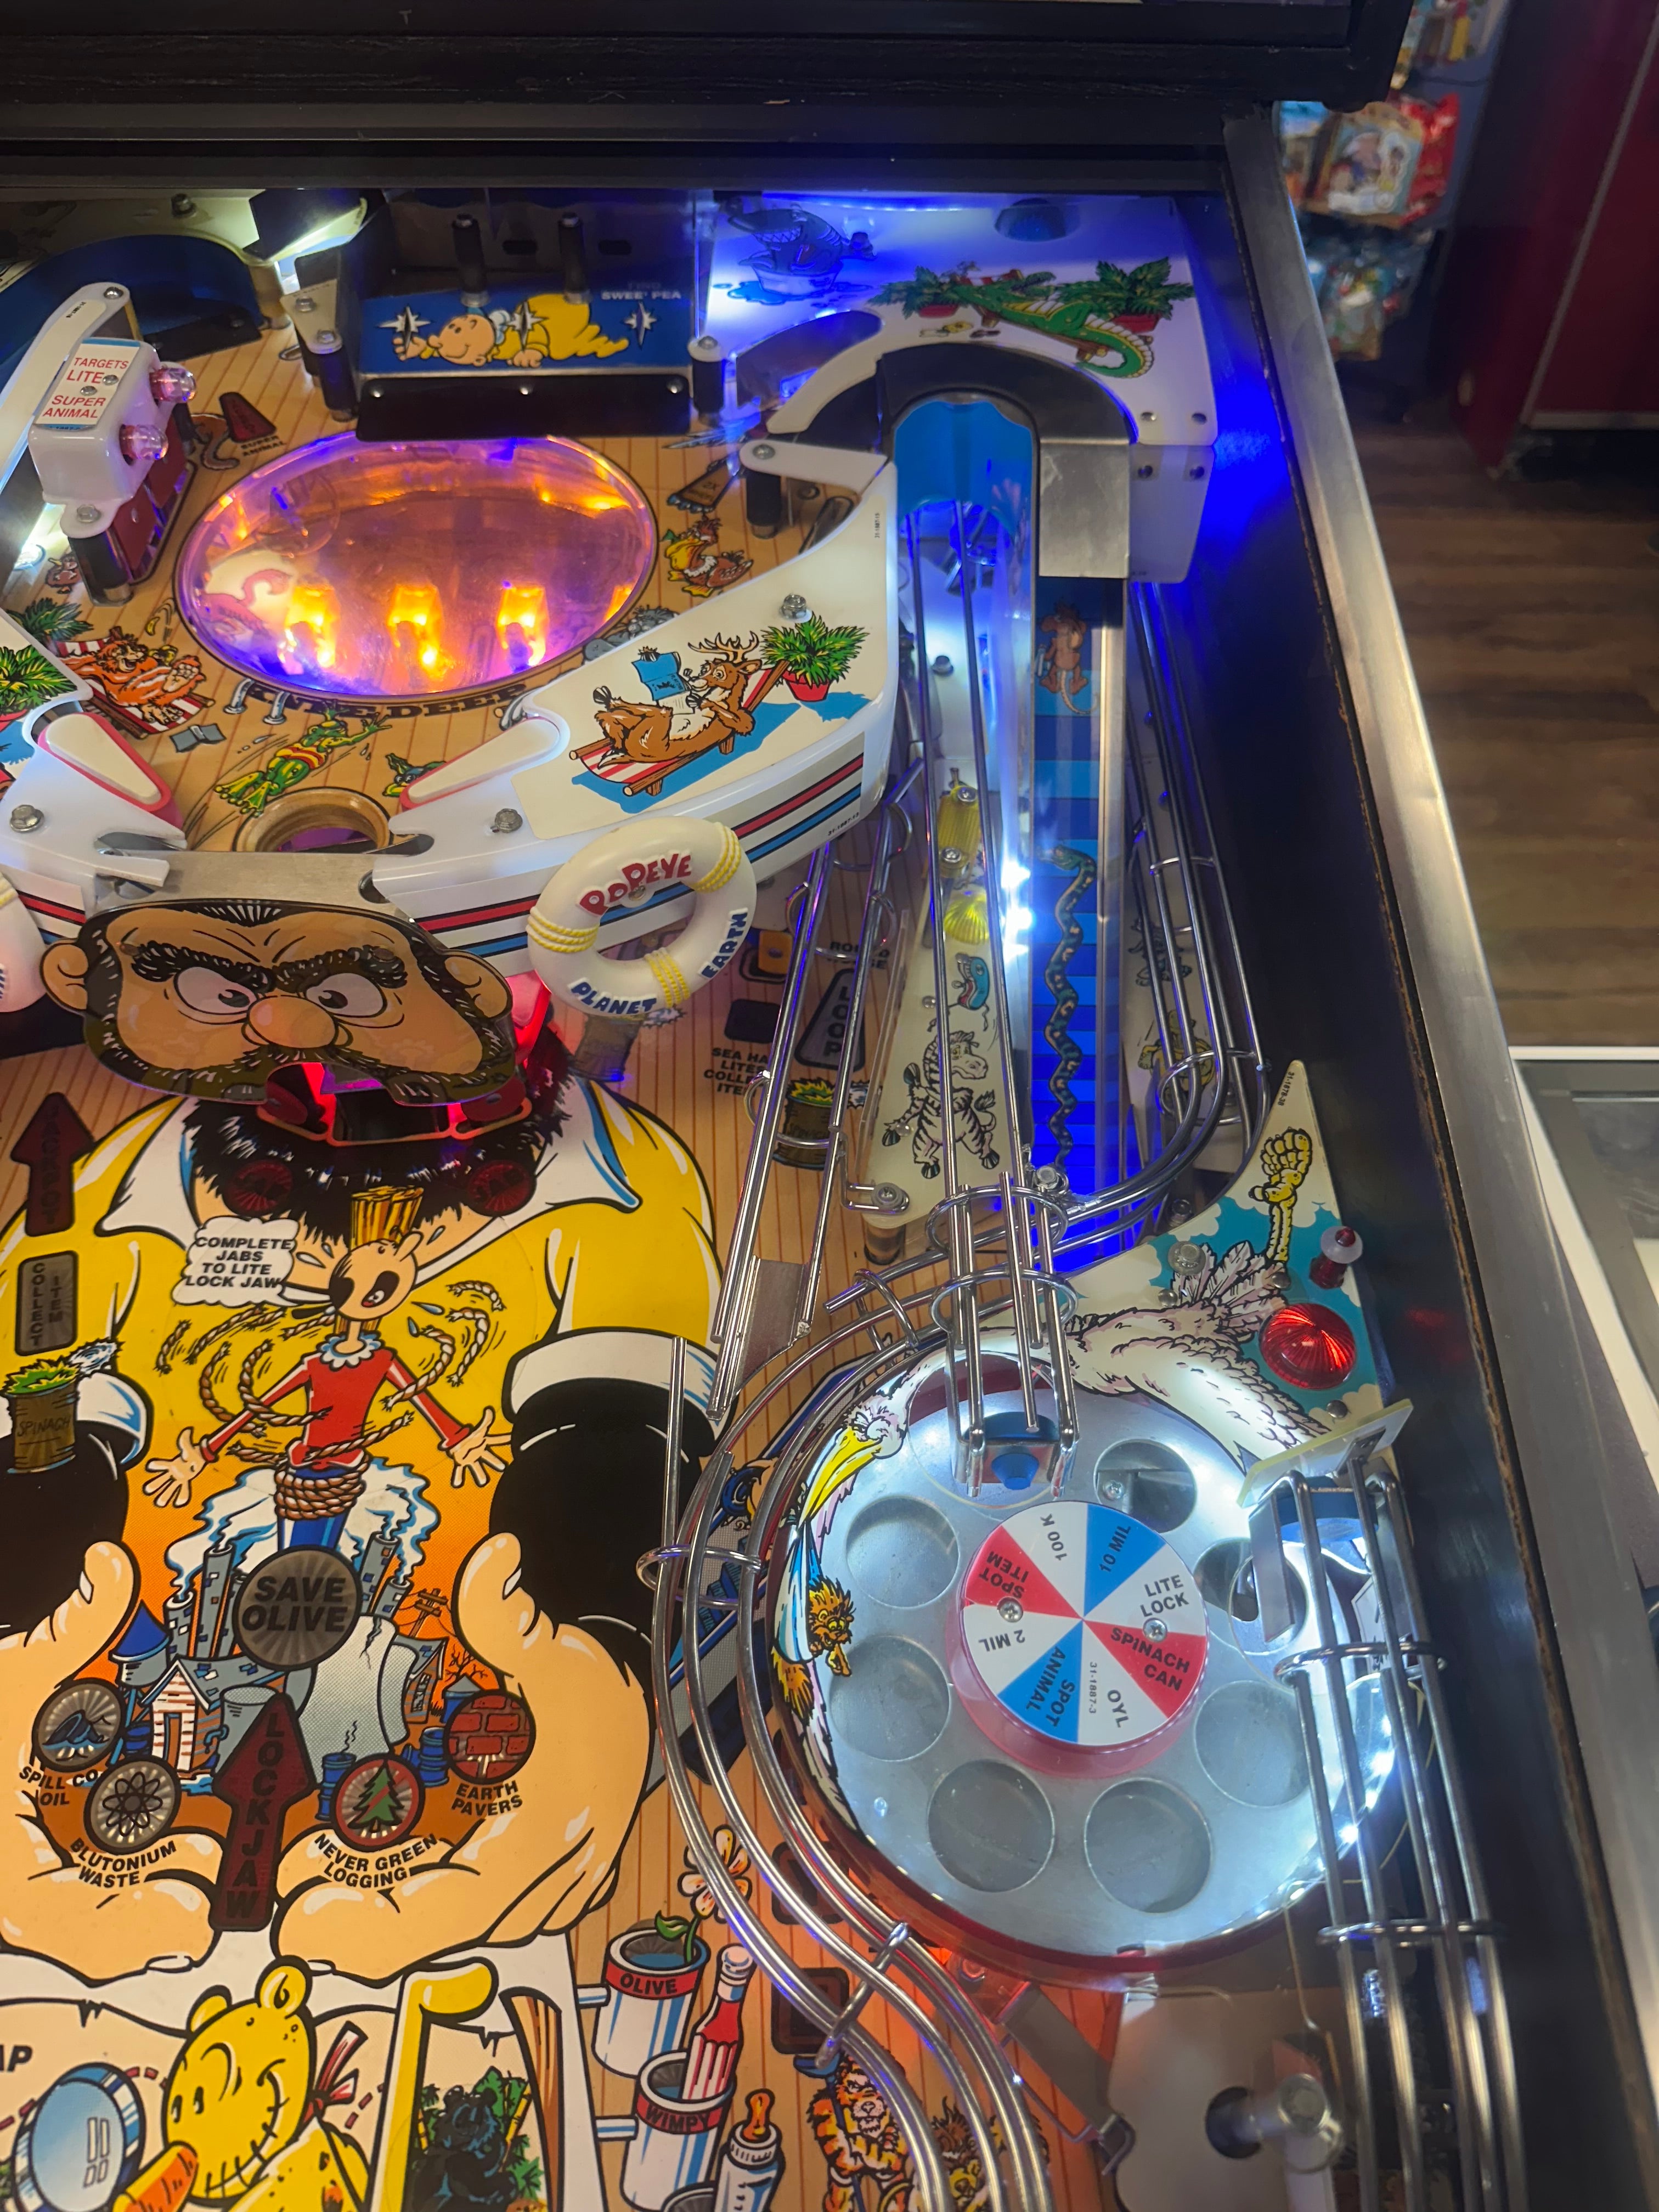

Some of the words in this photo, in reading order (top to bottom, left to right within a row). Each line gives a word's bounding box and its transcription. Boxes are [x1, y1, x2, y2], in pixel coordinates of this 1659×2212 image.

[651, 290, 681, 299] PEA
[73, 357, 129, 369] TARGETS
[66, 369, 105, 384] LITE
[43, 408, 98, 418] ANIMAL
[52, 394, 106, 407] SUPER
[386, 684, 527, 719] DEEP
[579, 853, 692, 916] POPEYE
[701, 912, 748, 979] EARTH
[571, 981, 657, 1015] PLANET
[712, 1047, 742, 1060] SEA
[747, 1052, 768, 1064] HA
[195, 1237, 292, 1249] COMPLETE
[216, 1250, 264, 1262] JABS
[202, 1262, 227, 1273] TO
[231, 1263, 272, 1274] LITE
[185, 1275, 236, 1287] LOCK
[240, 1277, 282, 1288] JAW
[30, 1262, 45, 1346] COLLECT
[48, 1275, 63, 1323] ITEM
[18, 1414, 71, 1437] SPINACH
[1040, 1513, 1056, 1527] K
[1047, 1530, 1068, 1561] 100
[1100, 1553, 1116, 1573] 10
[1110, 1525, 1132, 1551] MIL
[986, 1550, 1029, 1583] ITEM
[253, 1576, 346, 1603] SAVE
[978, 1567, 1025, 1599] SPOT
[1144, 1574, 1184, 1598] LITE
[1140, 1592, 1189, 1617] LOCK
[241, 1605, 347, 1632] OLIVE
[978, 1635, 1012, 1652] MIL
[1014, 1629, 1026, 1644] 2
[1110, 1627, 1191, 1674] SPINACH
[1025, 1646, 1066, 1711] ANIMAL
[1088, 1661, 1098, 1714] 31-1887-3
[1143, 1663, 1184, 1691] CAN
[1045, 1678, 1076, 1727] SPOT
[1107, 1688, 1130, 1729] OYL
[19, 1766, 65, 1789] SPILL
[456, 1780, 518, 1801] EARTH
[40, 1792, 70, 1806] OIL
[451, 1794, 523, 1816] PAVERS
[70, 1837, 177, 1872] BLUTONIUM
[314, 1833, 369, 1872] NEVER
[375, 1833, 438, 1871] GREEN
[78, 1865, 140, 1888] WASTE
[324, 1861, 408, 1888] LOGGING
[619, 1972, 678, 1995] OLIVE
[645, 2104, 710, 2132] WIMPY
